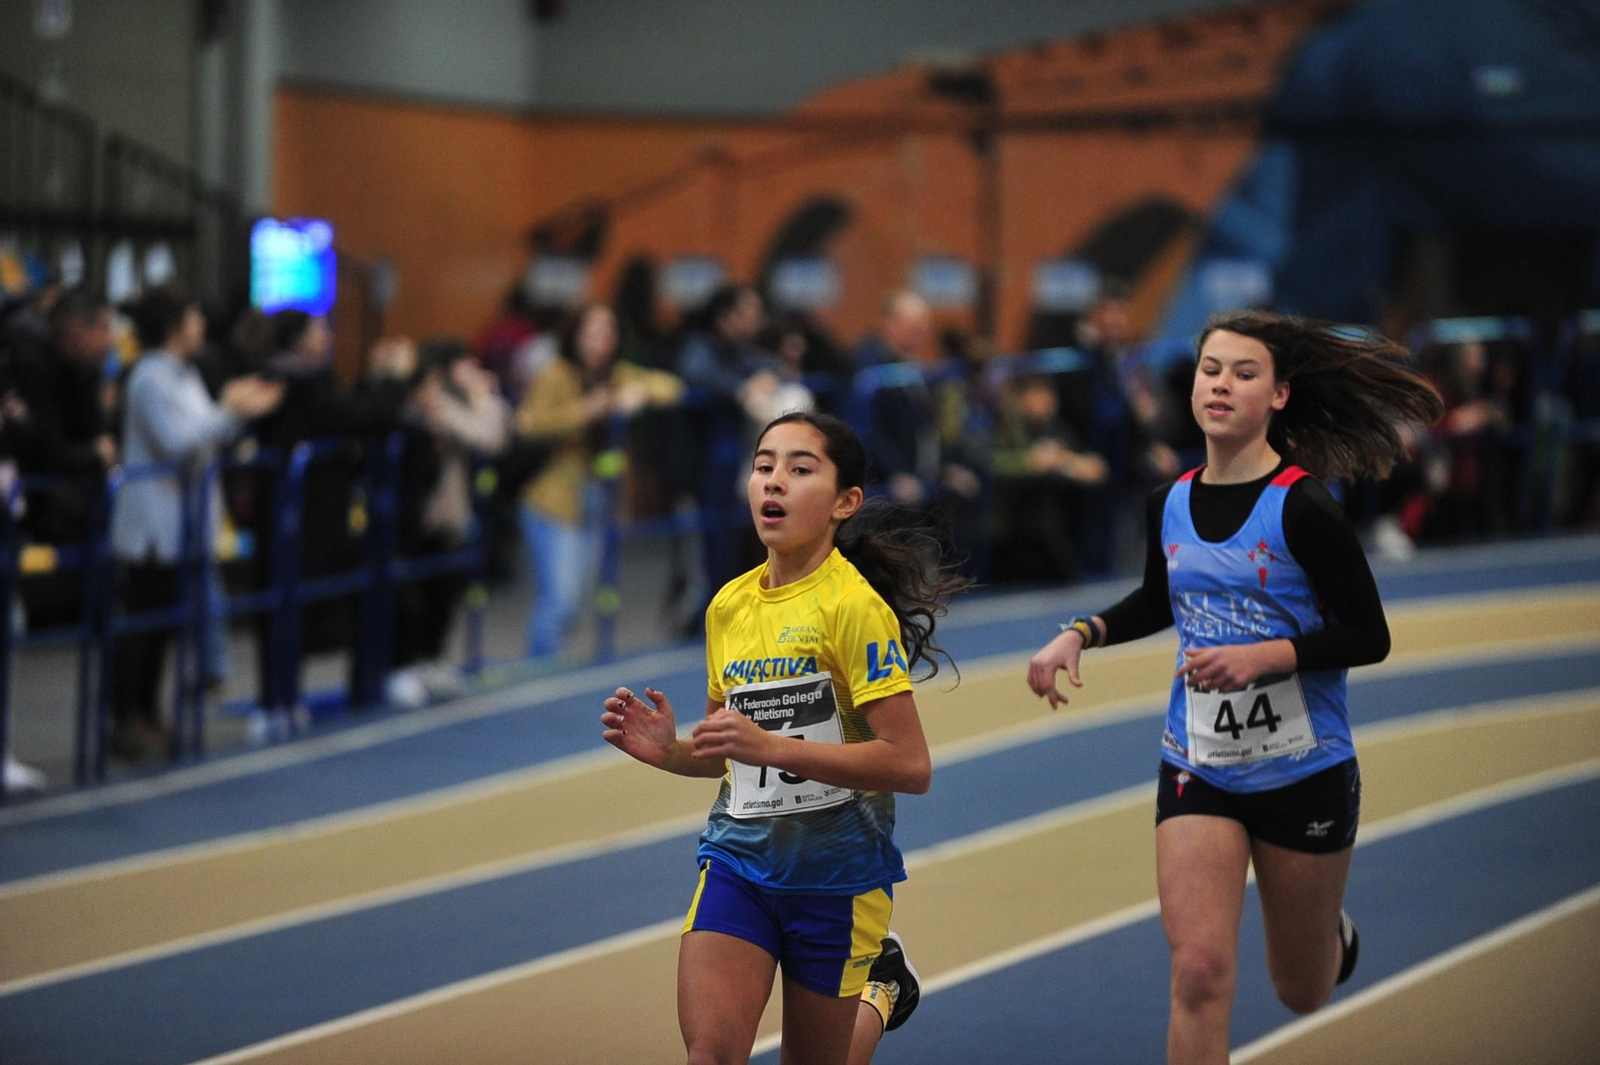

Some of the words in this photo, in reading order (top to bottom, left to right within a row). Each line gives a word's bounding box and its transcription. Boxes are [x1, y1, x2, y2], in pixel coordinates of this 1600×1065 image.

[743, 697, 781, 710] Federación
[782, 690, 823, 704] Galega
[753, 707, 795, 721] Atletismo
[1214, 692, 1282, 740] 44
[1207, 746, 1253, 759] atletismo.gal
[743, 797, 784, 810] atletismo.gal
